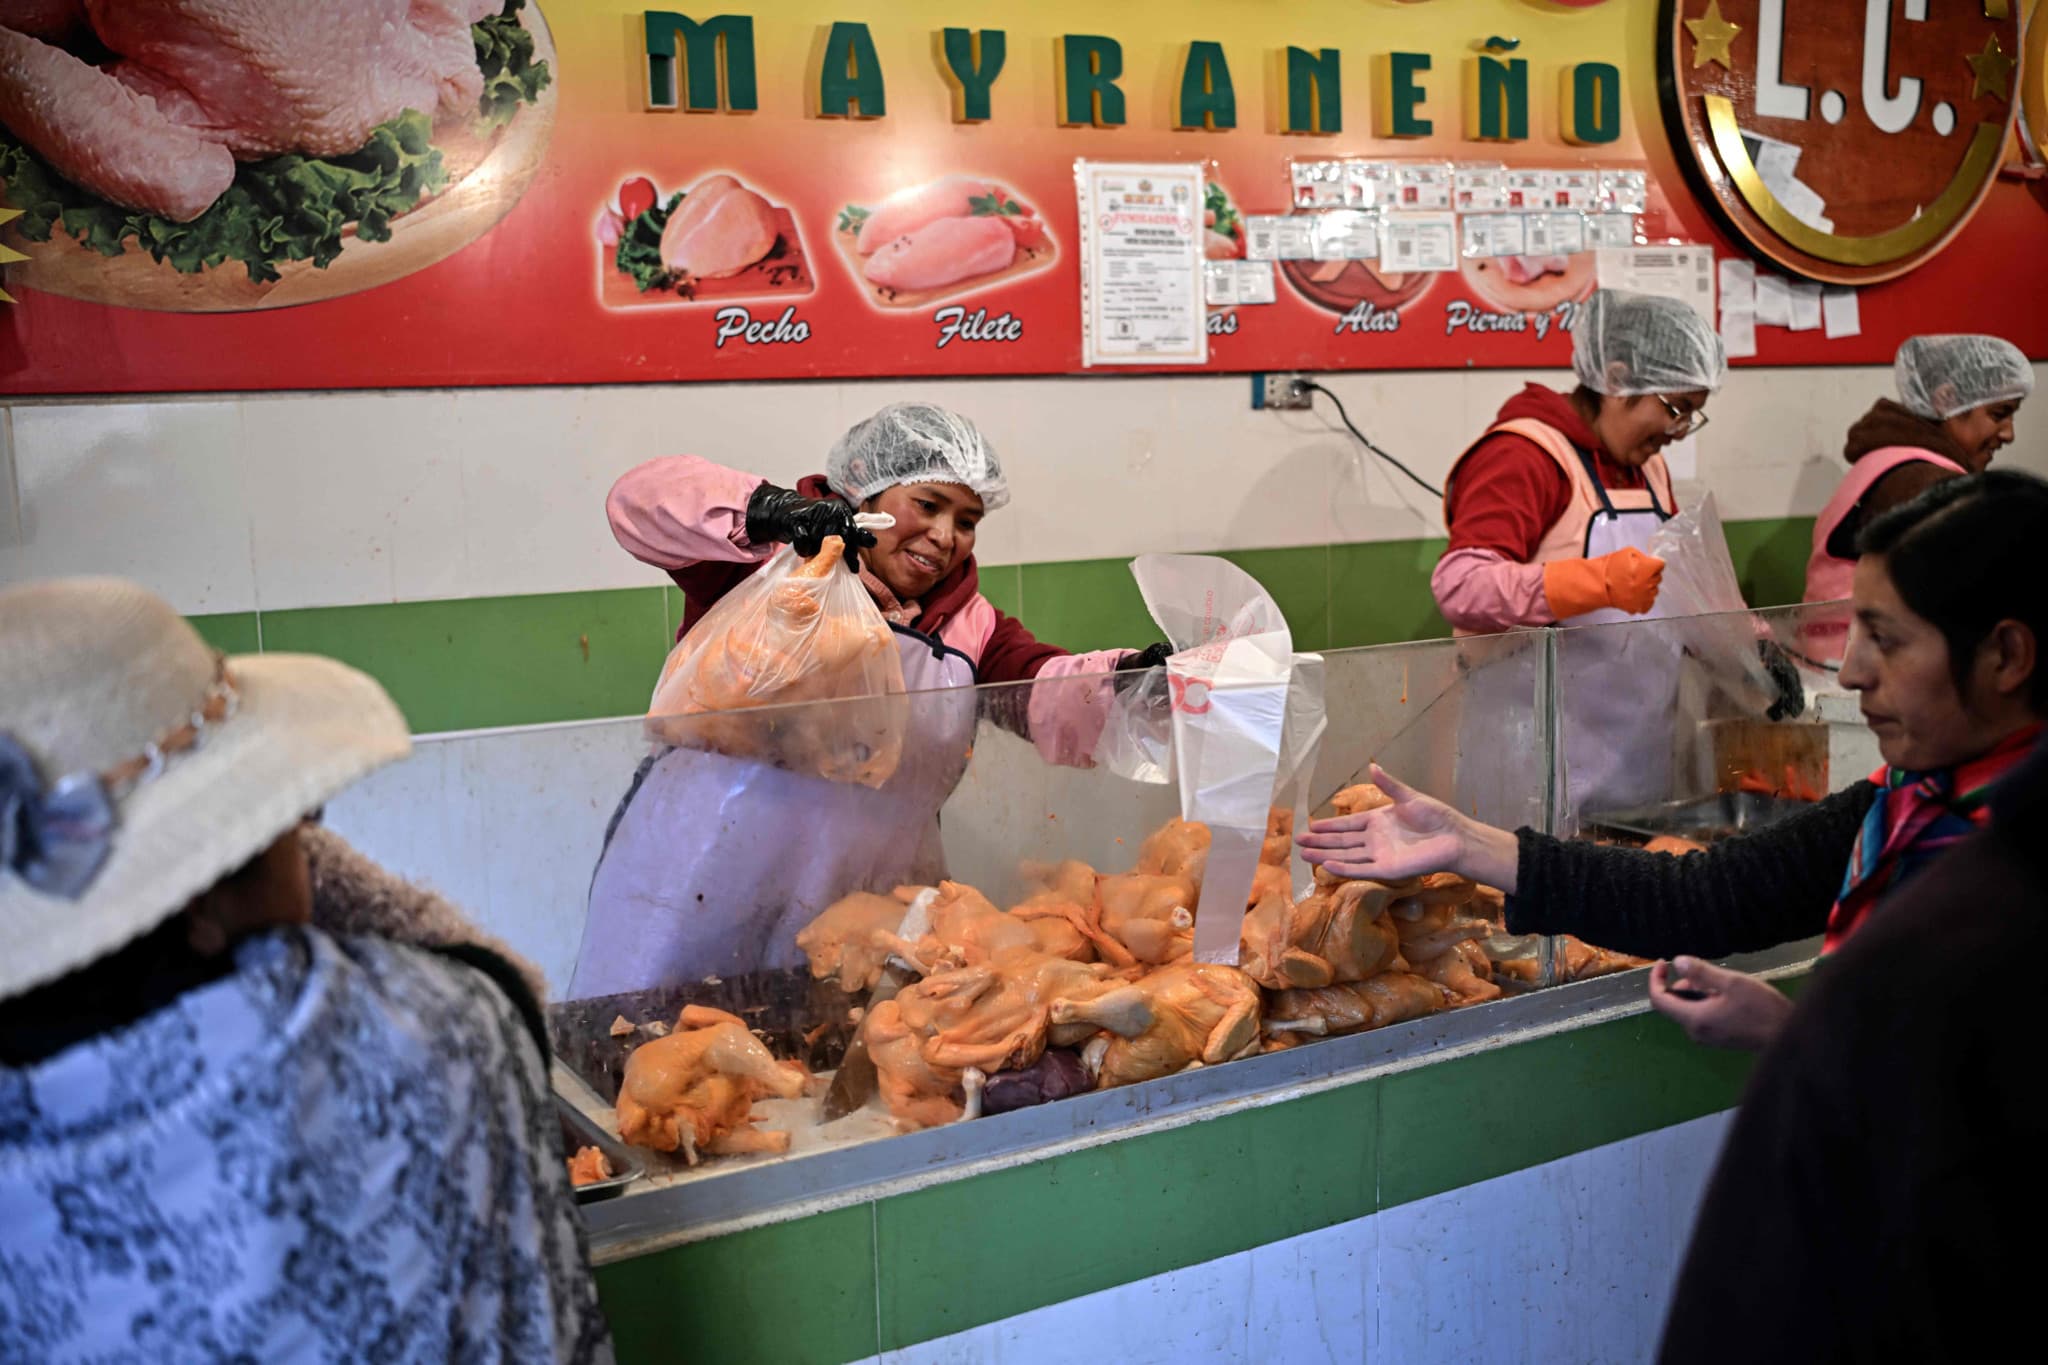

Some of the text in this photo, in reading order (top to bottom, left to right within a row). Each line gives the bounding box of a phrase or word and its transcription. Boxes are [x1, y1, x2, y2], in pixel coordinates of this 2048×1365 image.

[644, 10, 1621, 144] MAYRANEÑO
[715, 306, 810, 347] Pecho
[935, 307, 1022, 348] Filete
[1336, 300, 1400, 334] Alas
[1446, 300, 1526, 334] Pierna
[1535, 312, 1551, 341] y
